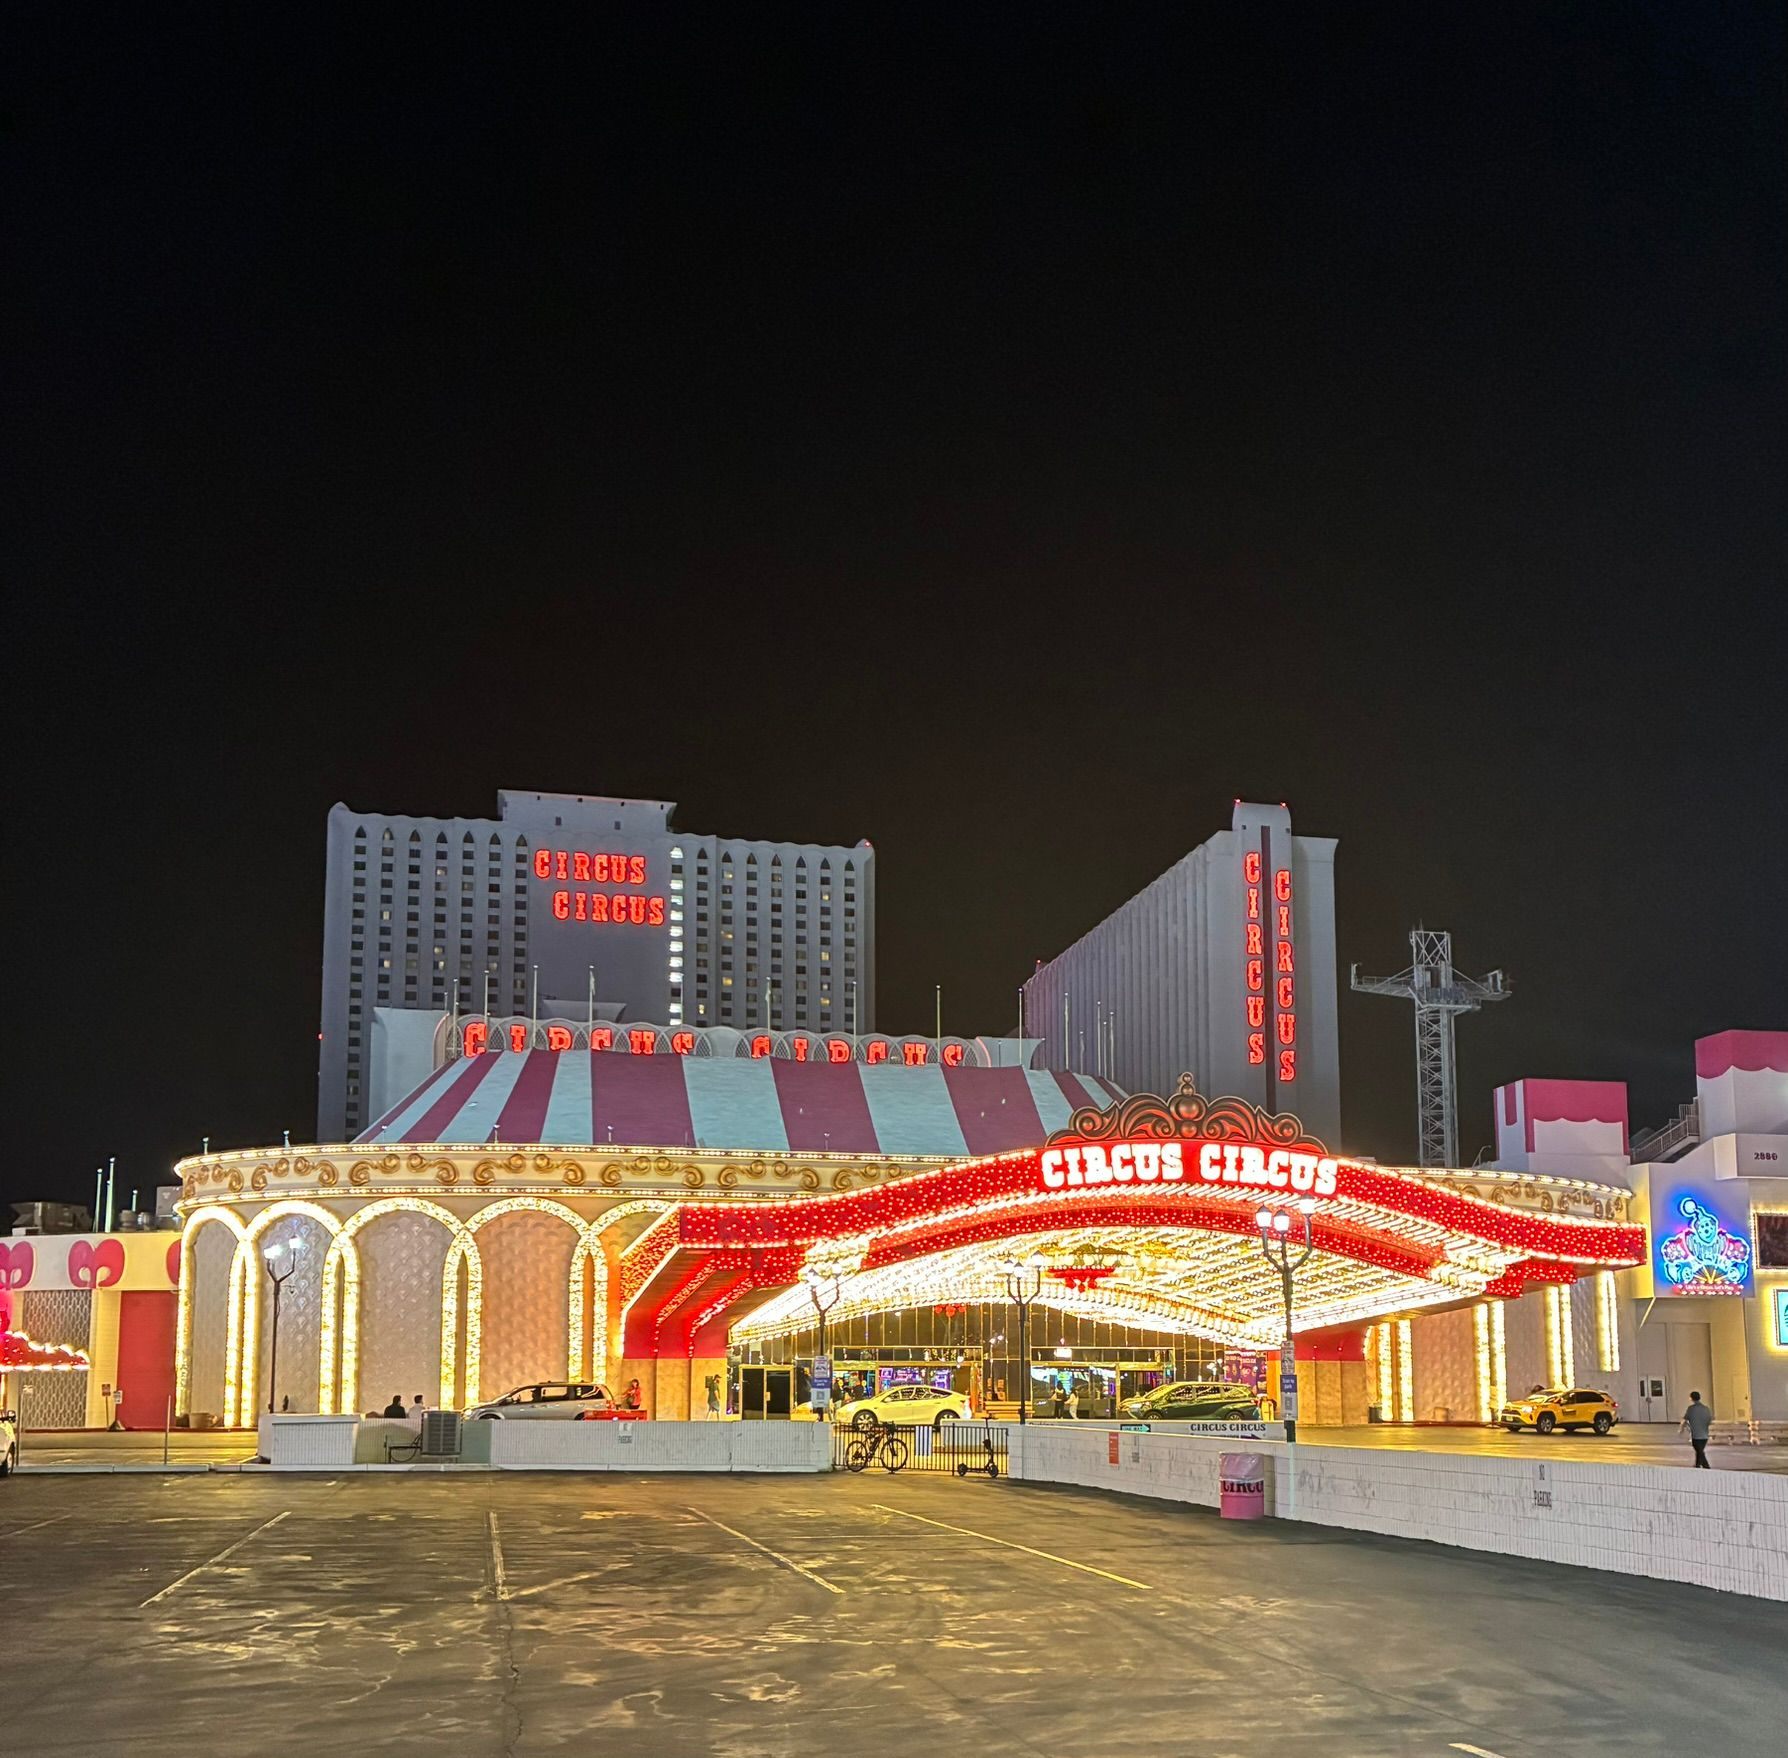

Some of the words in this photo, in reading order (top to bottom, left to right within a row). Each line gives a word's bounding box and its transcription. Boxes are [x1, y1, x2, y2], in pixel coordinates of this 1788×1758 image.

[534, 849, 646, 885] CIRCUS
[552, 890, 665, 926] CIRCUS
[1243, 851, 1265, 1065] CIRCUS
[1274, 869, 1296, 1082] CIRCUS
[1041, 1143, 1184, 1188] CIRCUS
[1200, 1143, 1338, 1195] CIRCUS
[1190, 1423, 1227, 1432] CIRCUS
[1229, 1423, 1266, 1432] CIRCUS
